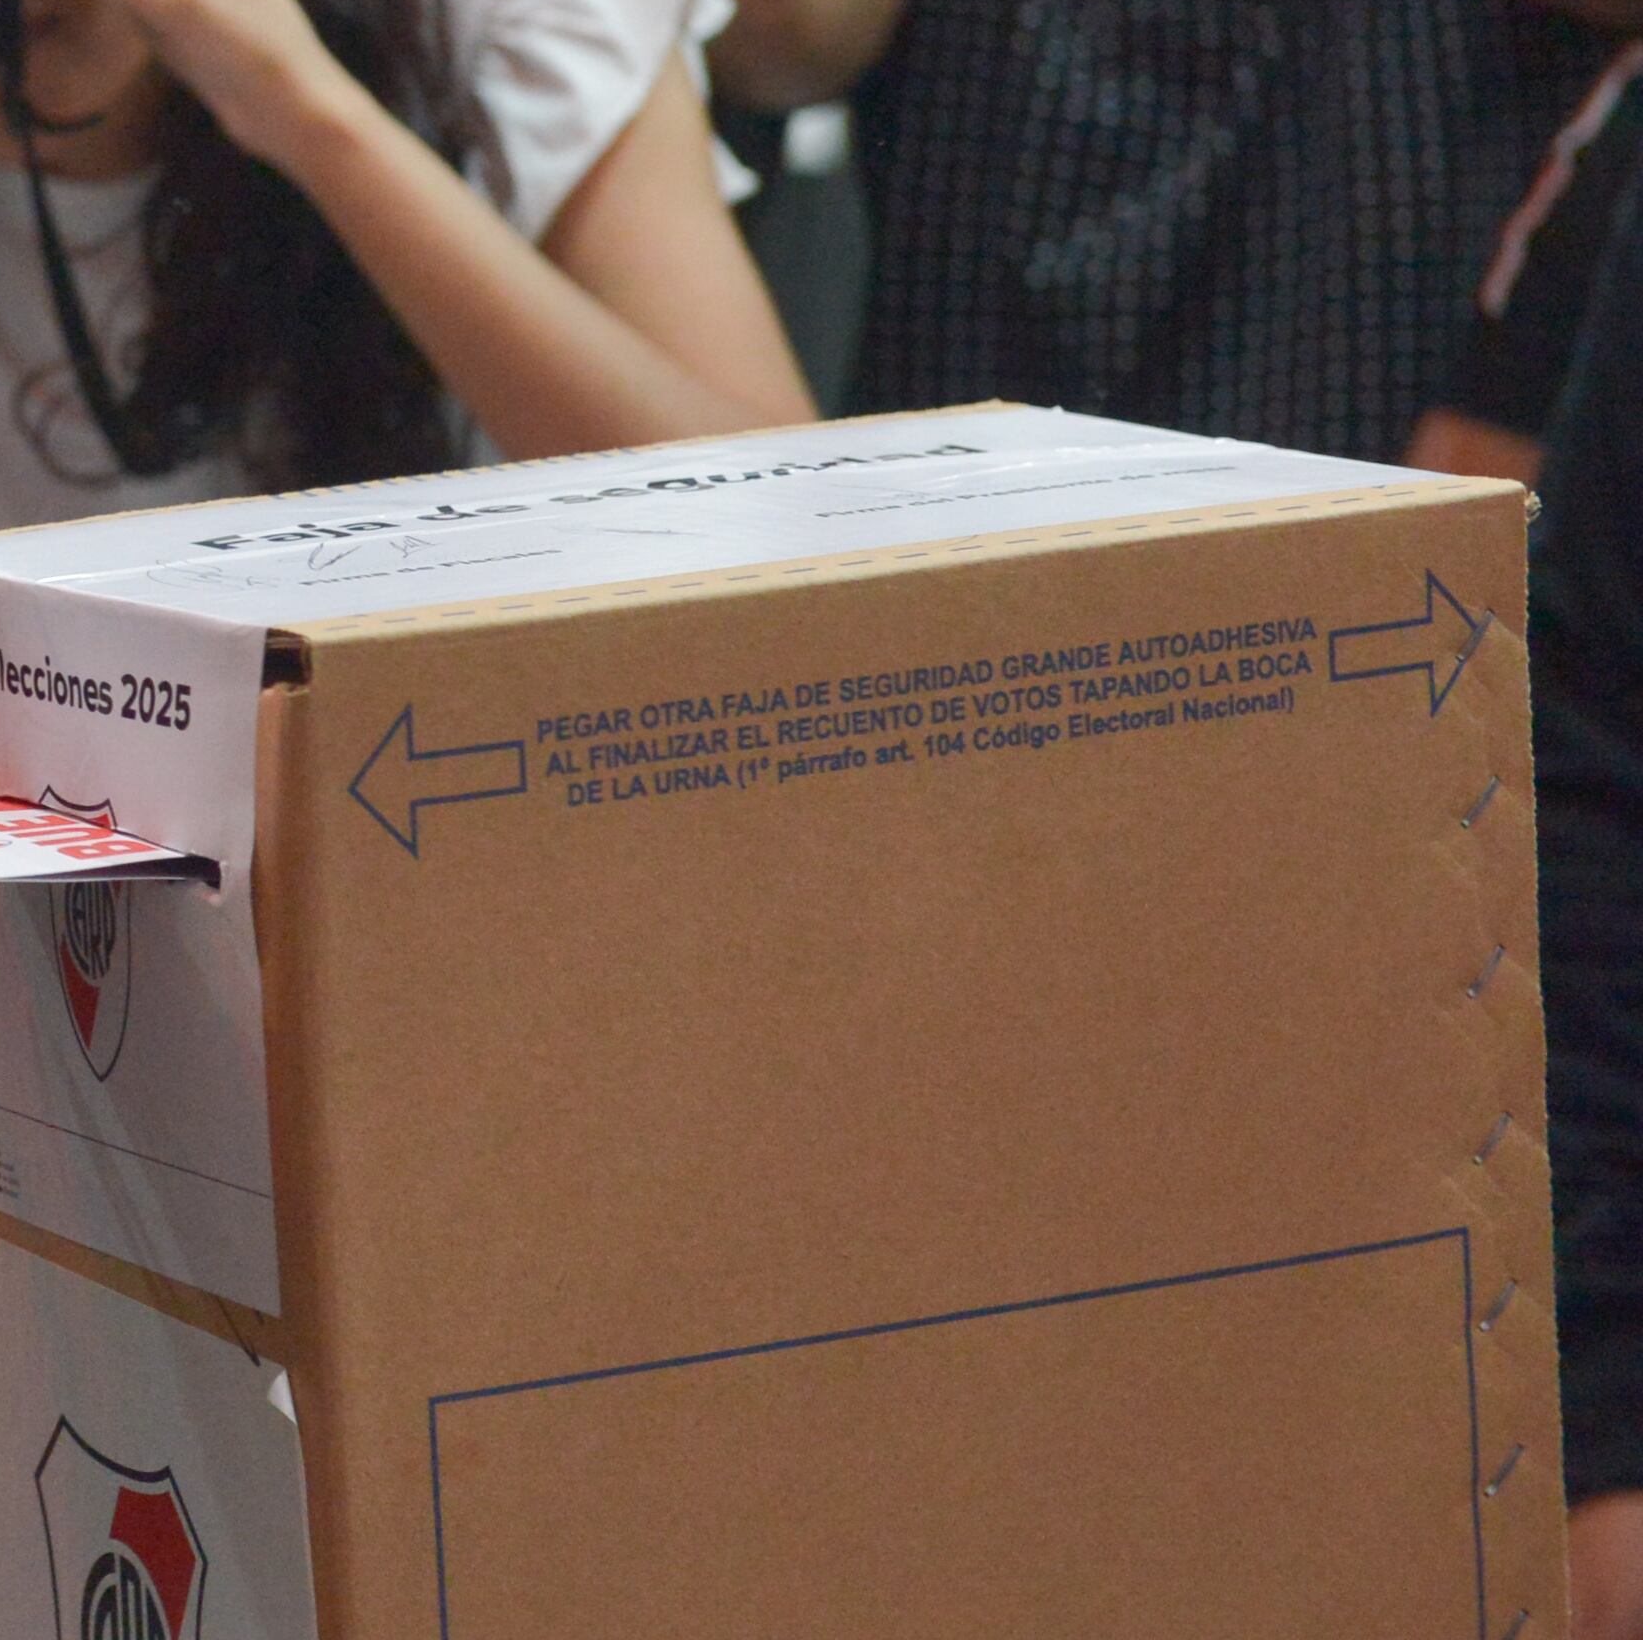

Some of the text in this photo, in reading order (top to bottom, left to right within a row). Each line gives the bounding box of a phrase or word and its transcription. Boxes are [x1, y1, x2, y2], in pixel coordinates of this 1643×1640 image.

[191, 520, 401, 552] Faja
[417, 504, 532, 522] de
[120, 673, 192, 731] 2025
[536, 616, 1317, 744] PEGAR OTRA FAJA DE SEGURIDAD GRANDE AUTOADHESIVA
[545, 650, 1313, 778] AL FINALIZAR EL RECUENTO DE VOTOS TAPANDO LA BOCA
[567, 780, 604, 807] DE
[614, 773, 648, 801] LA
[654, 763, 731, 795] URNA
[777, 743, 867, 782] párrafo
[874, 738, 915, 764] art.
[923, 732, 965, 759] 104
[972, 722, 1061, 752] Código
[1067, 701, 1176, 740] Electoral
[1182, 685, 1295, 723] Nacional)
